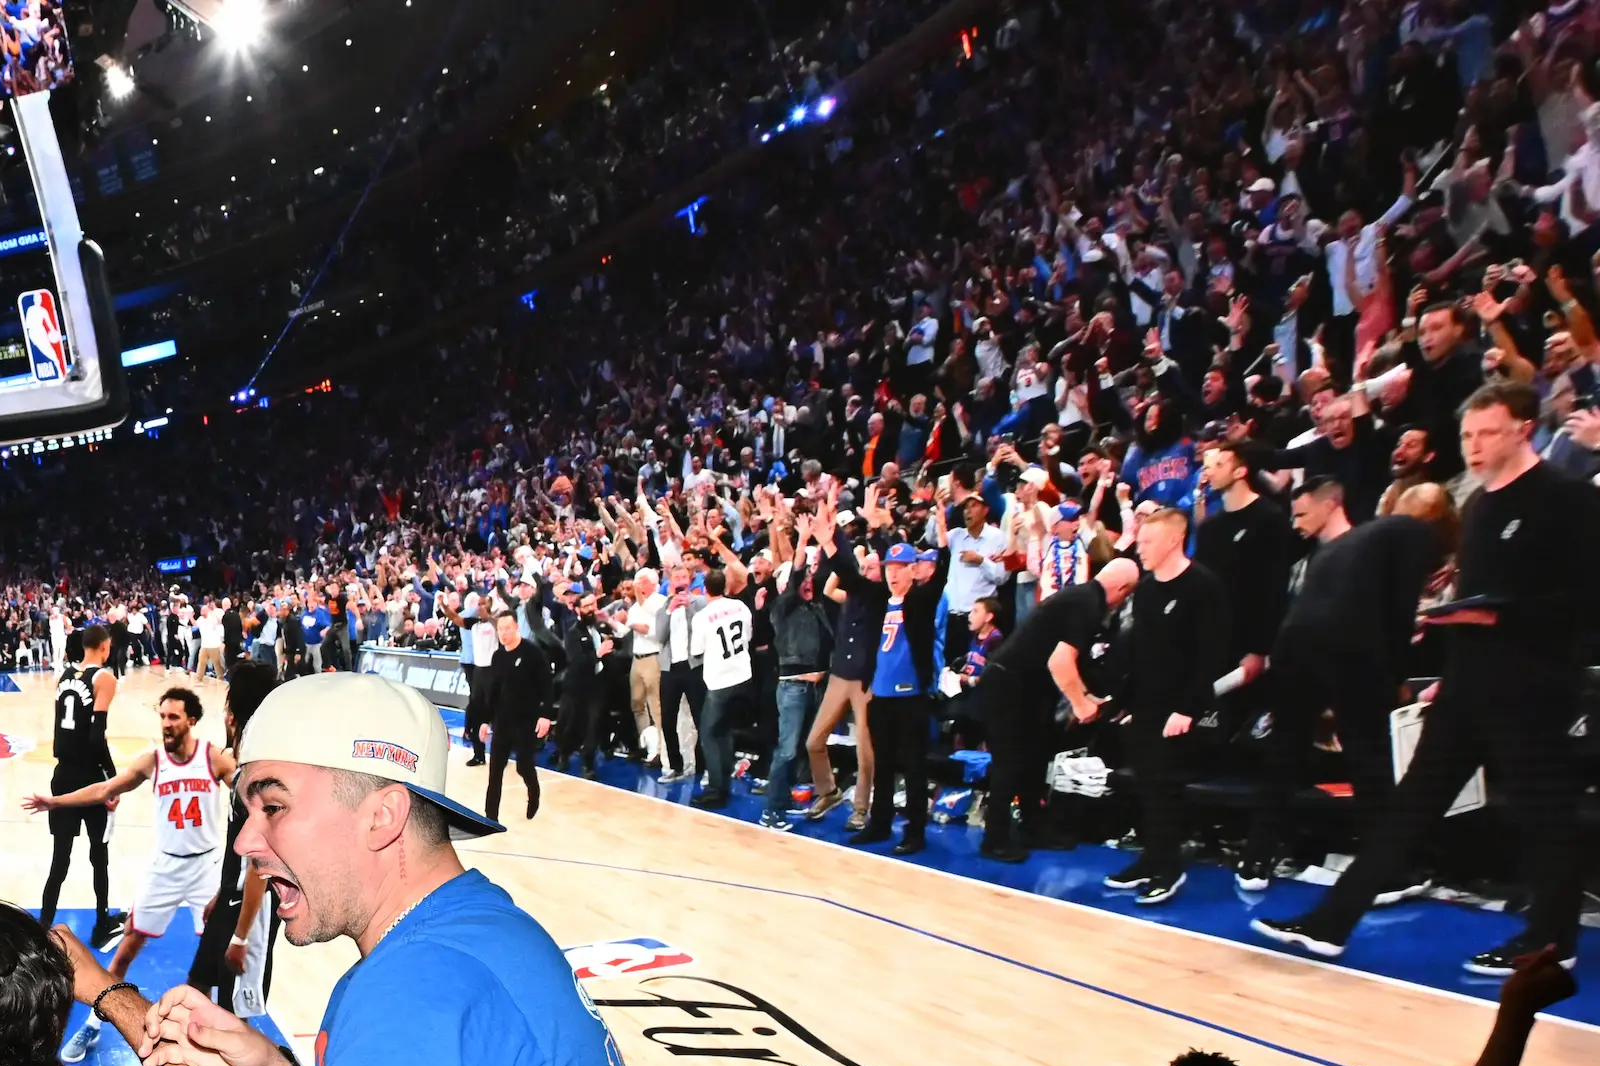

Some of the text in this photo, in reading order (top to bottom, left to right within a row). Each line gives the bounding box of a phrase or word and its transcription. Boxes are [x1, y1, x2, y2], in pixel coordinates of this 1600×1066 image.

[716, 619, 744, 660] 12
[882, 624, 899, 652] 7
[60, 694, 76, 730] 1
[352, 740, 419, 773] NEW YORK
[158, 778, 212, 797] NEW YORK
[168, 796, 203, 829] 44
